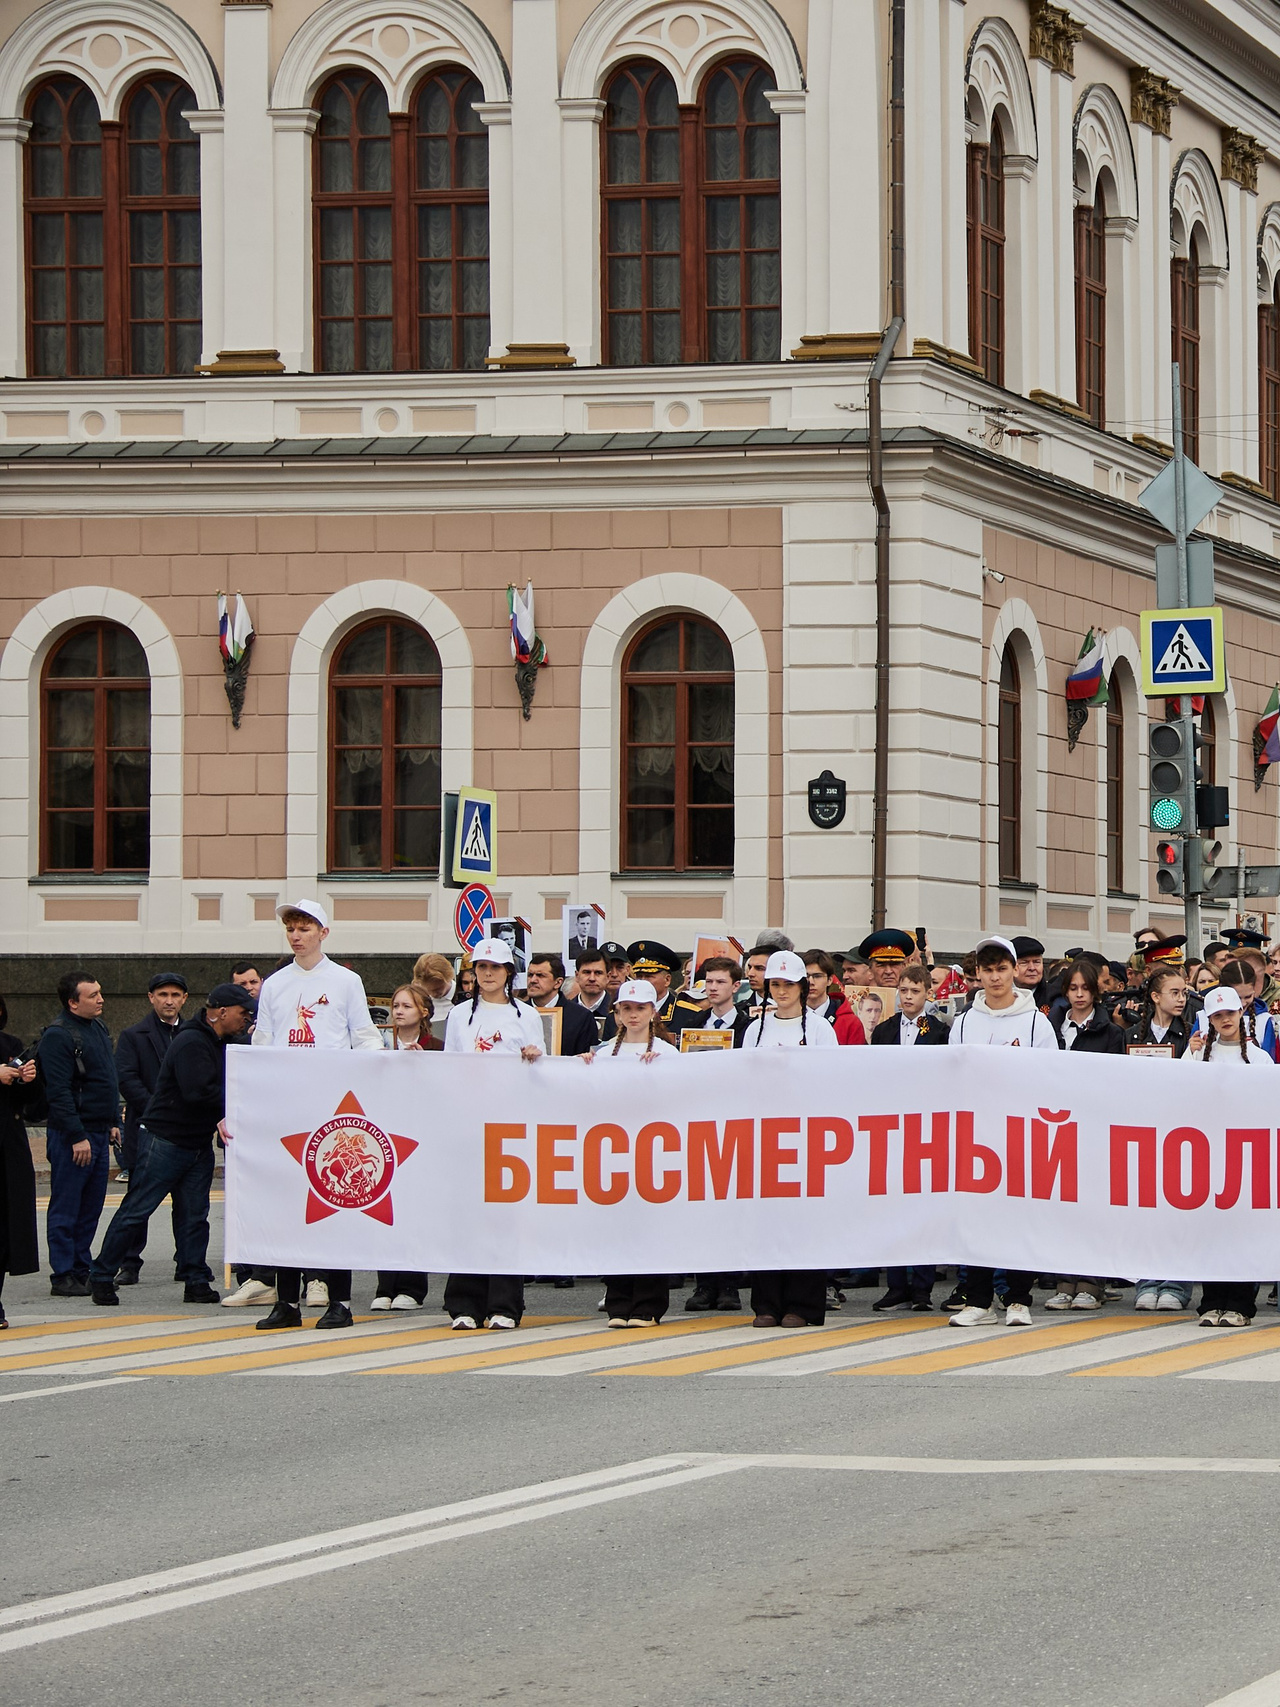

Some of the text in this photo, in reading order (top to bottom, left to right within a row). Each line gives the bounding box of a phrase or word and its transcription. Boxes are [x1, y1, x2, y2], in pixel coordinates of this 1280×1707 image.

[288, 1029, 304, 1042] 80
[307, 1118, 393, 1163] 80 ЛЕТ ВЕЛИКОЙ ПОБЕДЫ
[484, 1107, 1078, 1205] БЕССМЕРТНЫЙ
[328, 1195, 344, 1206] 1941
[356, 1194, 373, 1205] 1945
